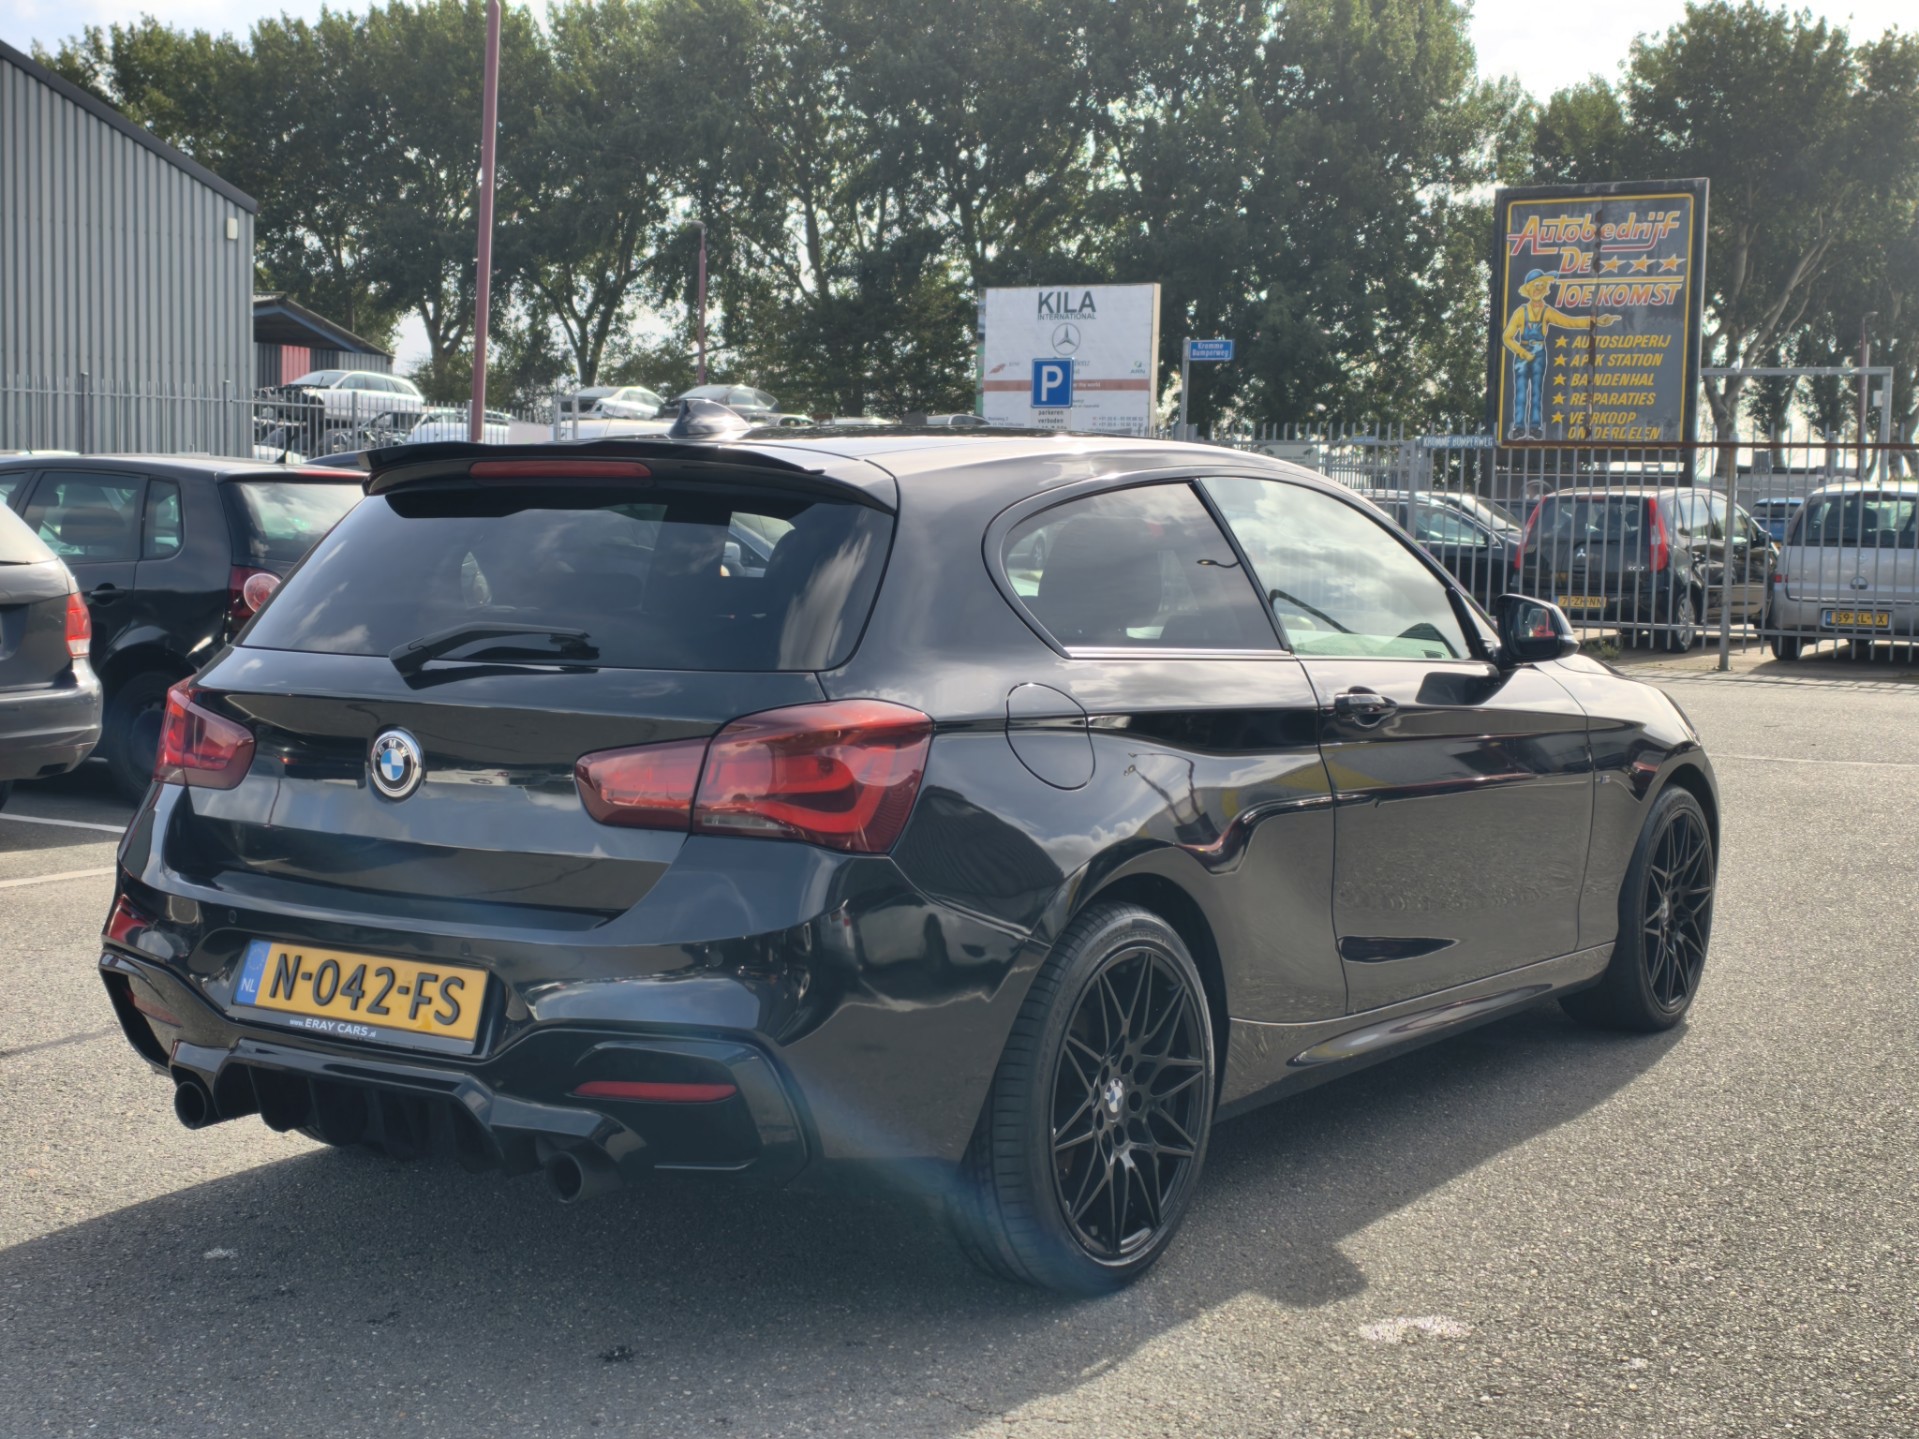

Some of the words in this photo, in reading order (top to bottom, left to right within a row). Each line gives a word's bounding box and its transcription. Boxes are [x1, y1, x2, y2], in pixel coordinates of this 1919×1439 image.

[1507, 211, 1681, 255] Autobedrijf
[1559, 246, 1594, 274] DE
[1554, 275, 1684, 308] TOEKOMST
[1038, 290, 1096, 313] KILA
[1571, 335, 1672, 349] AUTOSLOPERIJ
[1570, 353, 1605, 368] APK
[1607, 353, 1664, 367] STATION
[1041, 365, 1064, 402] P
[1570, 373, 1655, 387] BANDENHAL
[1569, 392, 1657, 406] REPARATIES
[1569, 411, 1637, 425] VERKOOP
[378, 739, 409, 757] BMW
[241, 978, 255, 992] NL
[269, 953, 465, 1026] N-042-FS
